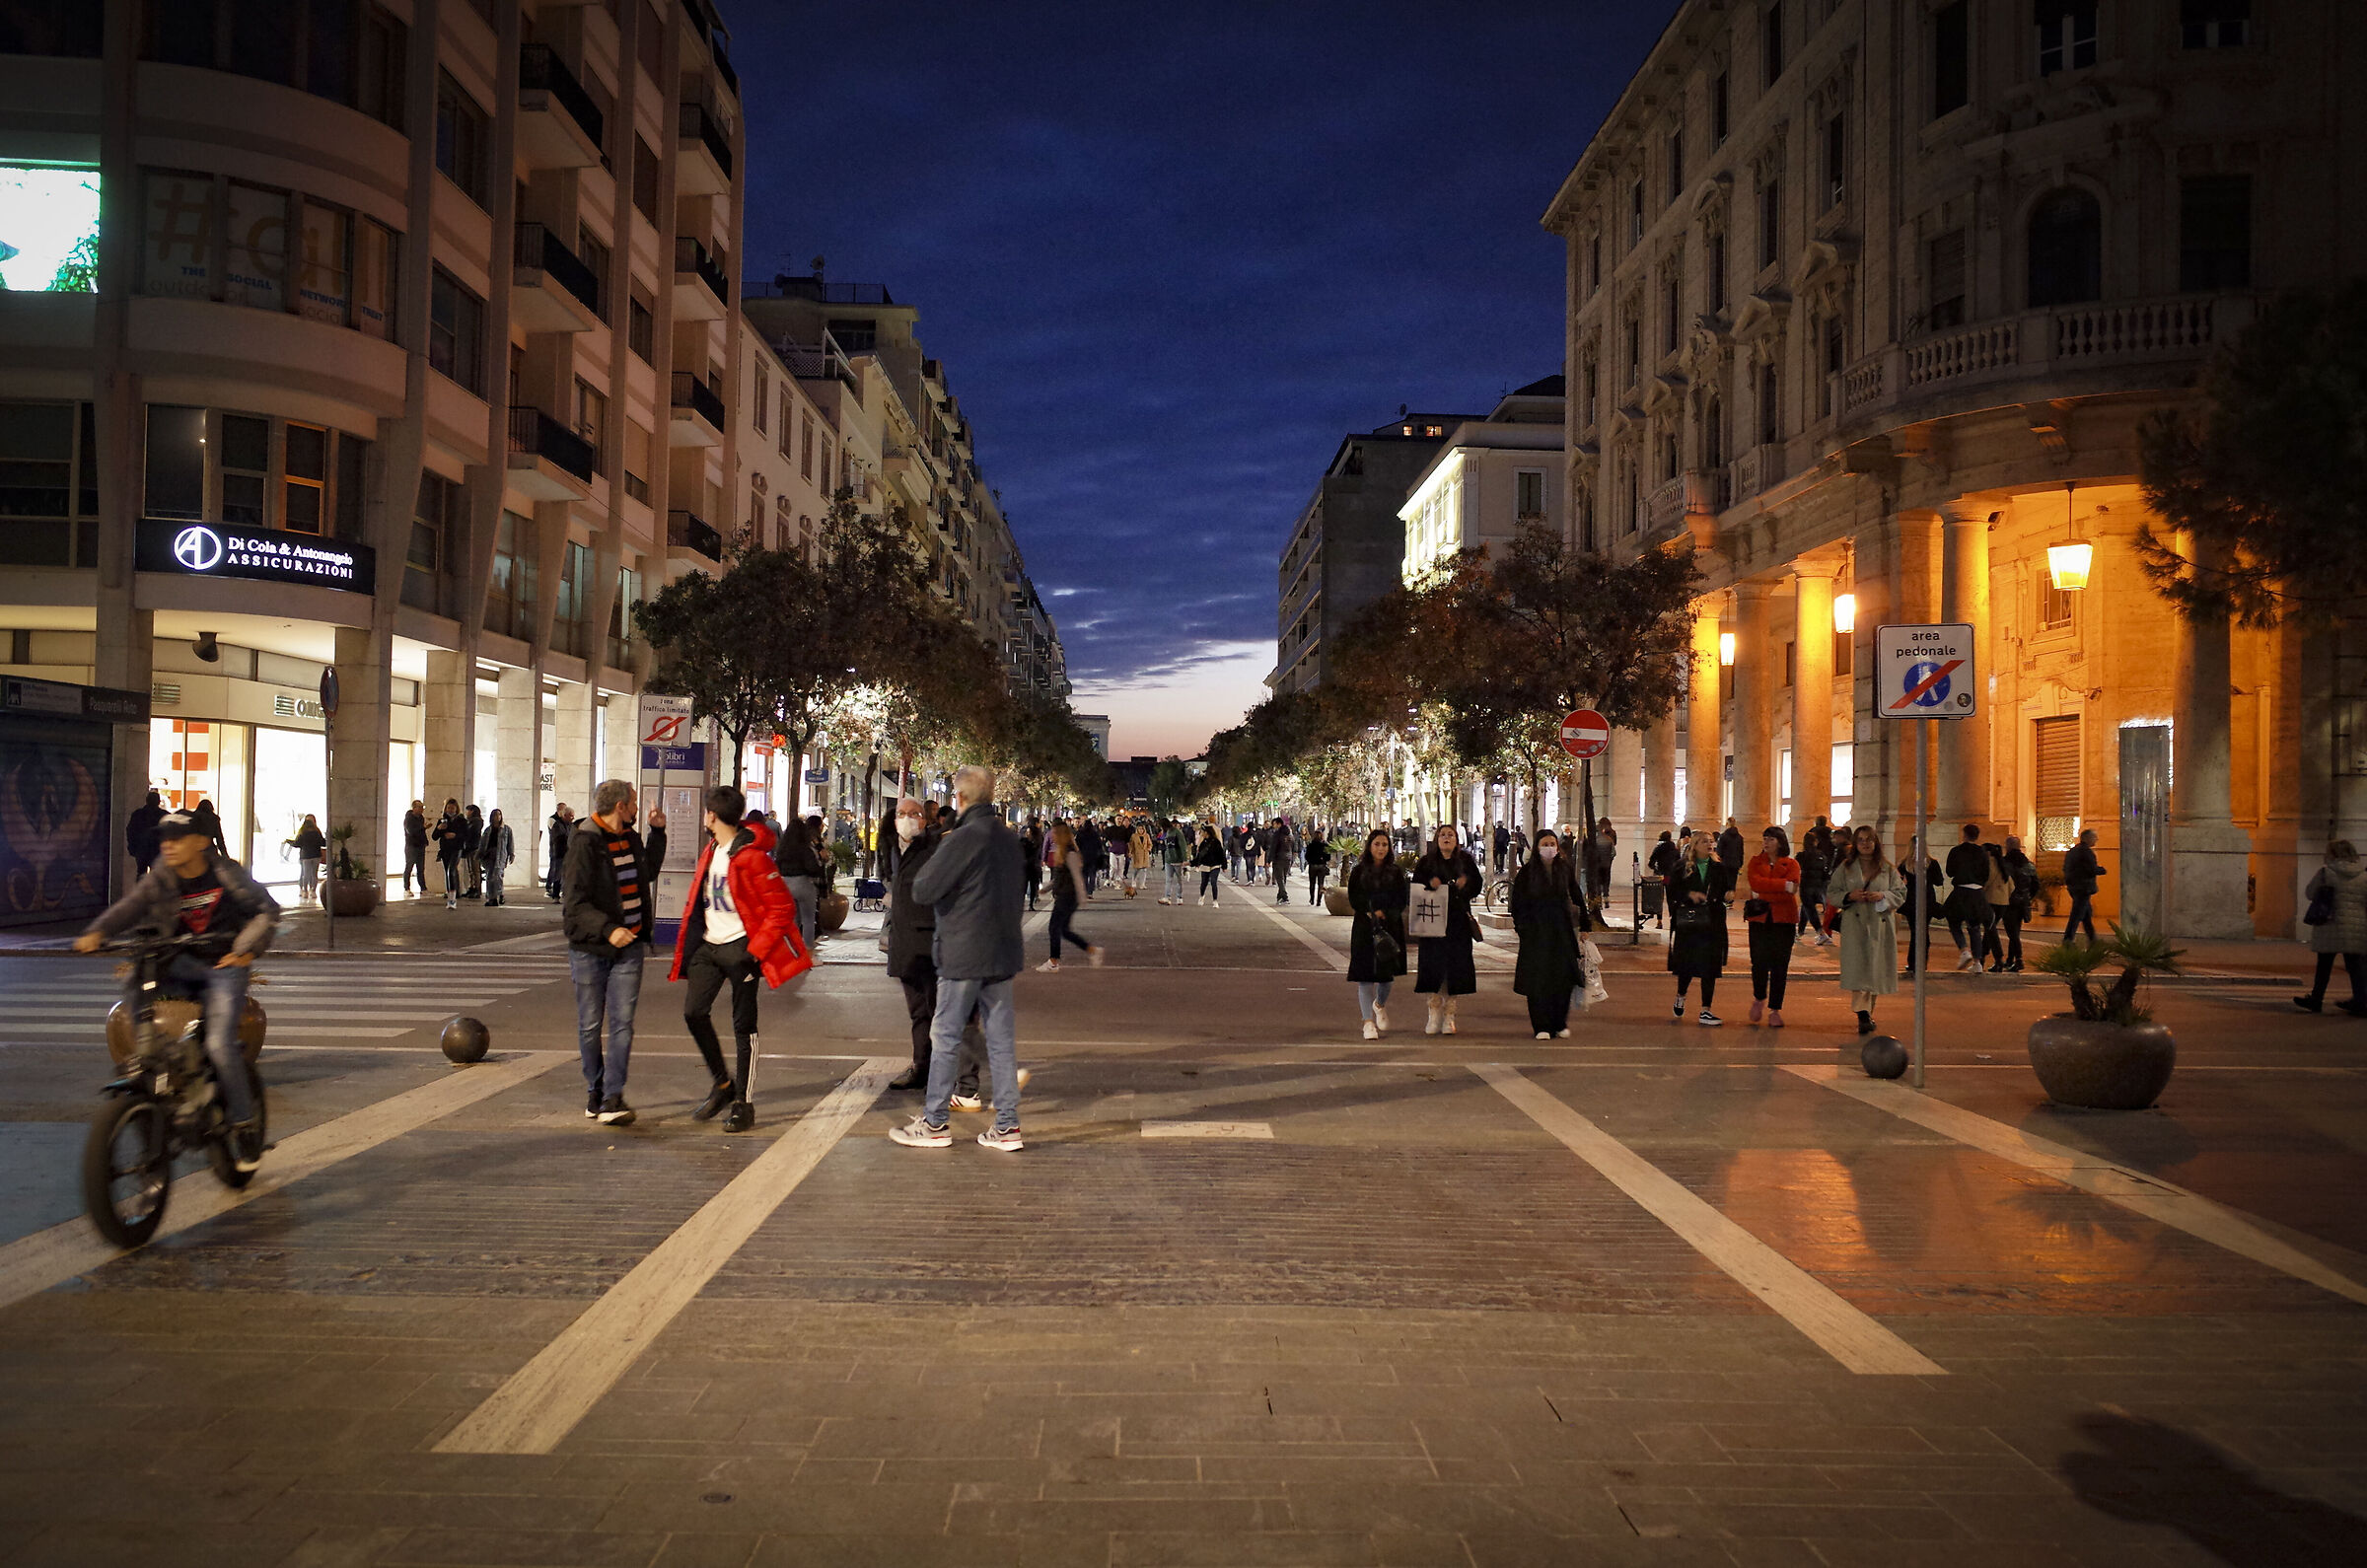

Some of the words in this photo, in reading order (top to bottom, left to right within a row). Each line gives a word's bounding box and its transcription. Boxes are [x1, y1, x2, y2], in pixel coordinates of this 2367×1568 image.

[180, 265, 205, 277] THE
[299, 288, 347, 309] NETWOR
[228, 536, 246, 551] Di
[247, 538, 277, 555] Cola
[278, 542, 292, 556] &
[227, 552, 353, 580] ASSICURAZIONI
[1911, 631, 1940, 641] area
[1896, 645, 1957, 659] pedonale
